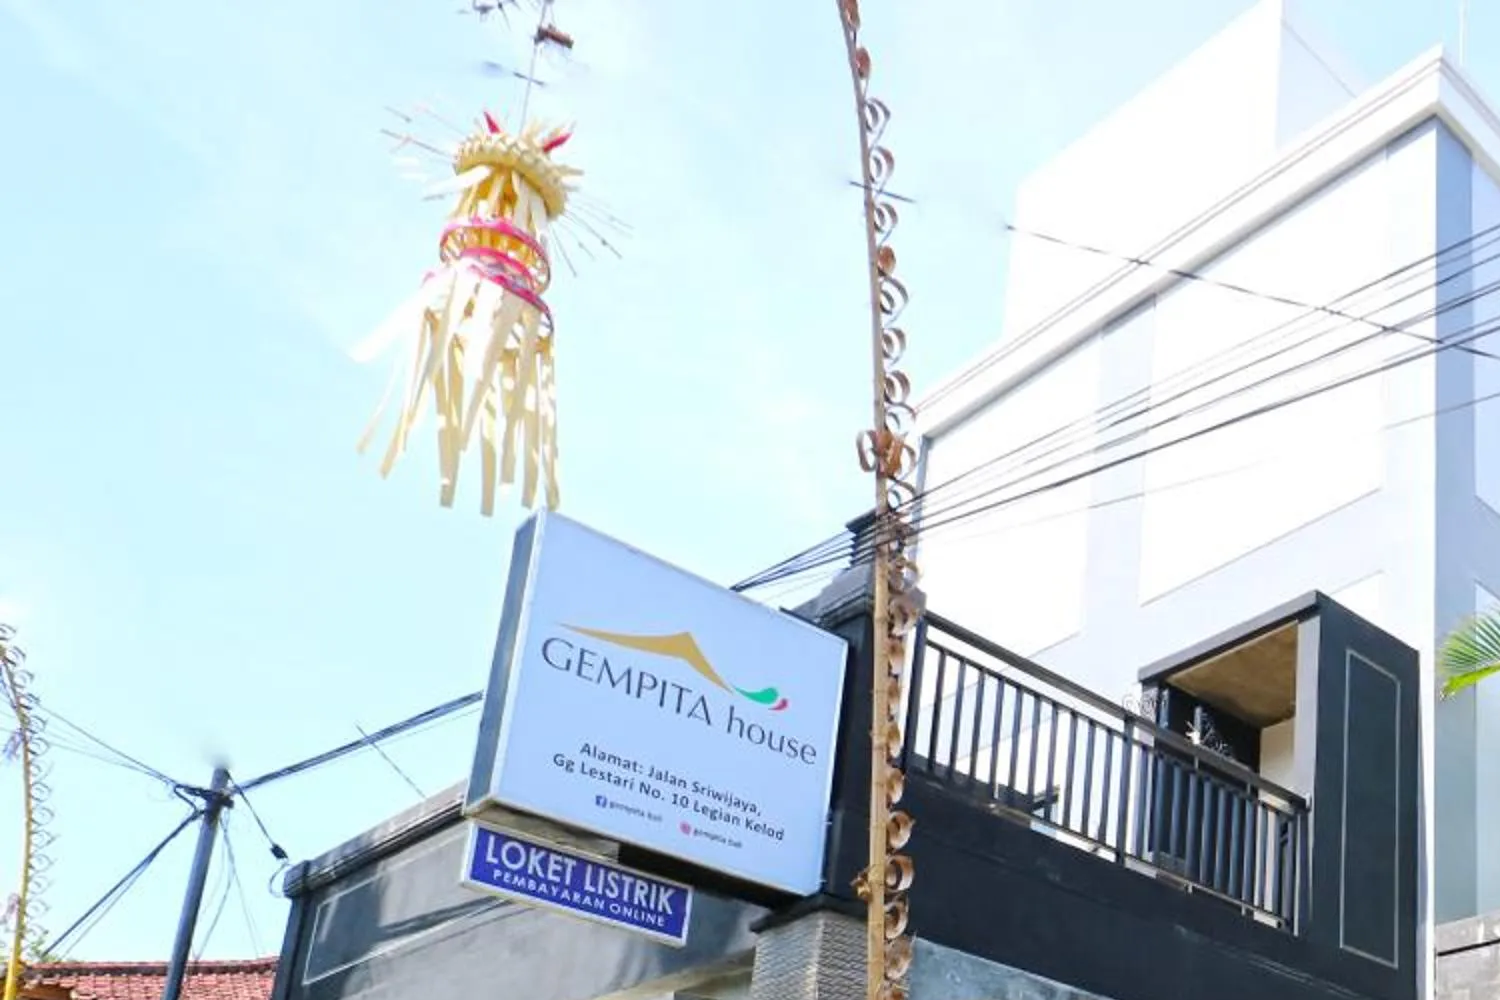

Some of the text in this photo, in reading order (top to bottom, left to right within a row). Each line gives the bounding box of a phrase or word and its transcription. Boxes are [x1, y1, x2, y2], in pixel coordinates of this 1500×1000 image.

[541, 636, 818, 766] GEMPITA house
[552, 752, 785, 842] Gg Lestari No. 10 Legian Kelod
[579, 741, 762, 818] Alamat: Jalan Sriwijaya,
[485, 832, 676, 916] LOKET LISTRIK
[492, 868, 666, 928] PEMBAYARAN ONLINE
